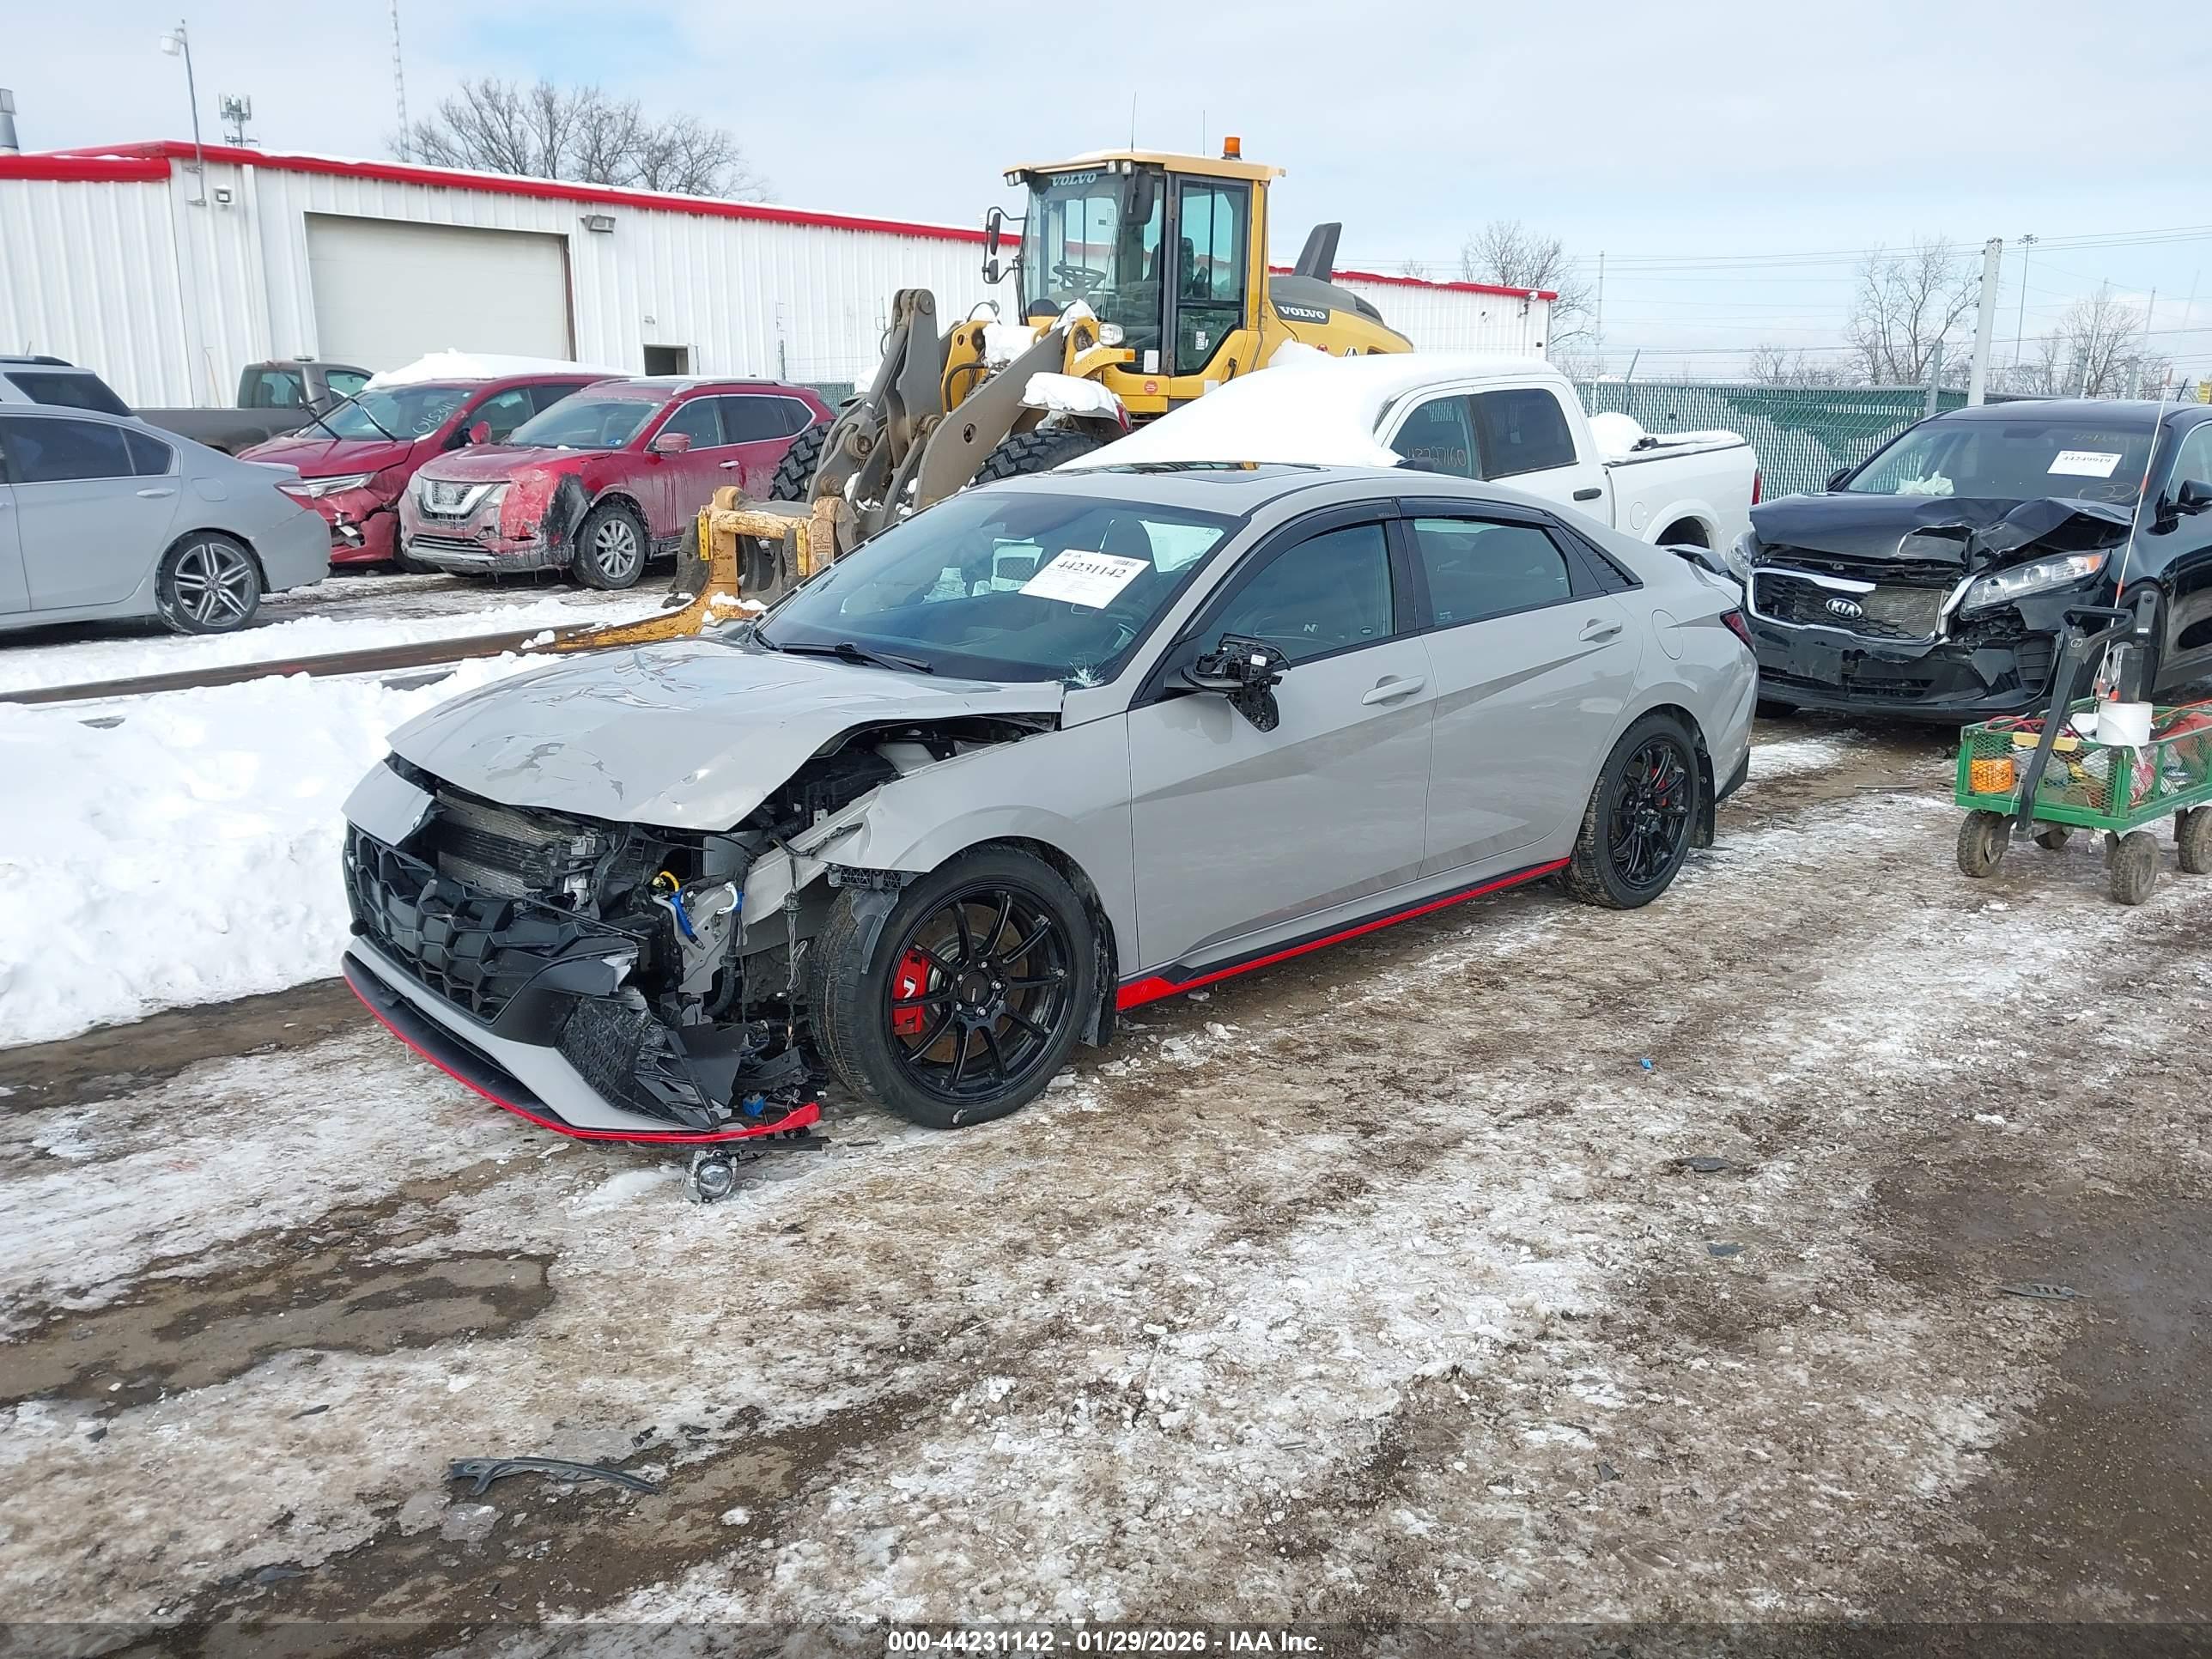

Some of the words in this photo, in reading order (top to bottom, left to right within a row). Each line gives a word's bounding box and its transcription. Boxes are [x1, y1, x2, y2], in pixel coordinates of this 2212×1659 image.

[1051, 173, 1097, 187] VOLVO
[1277, 305, 1326, 319] VOLVO
[1057, 560, 1127, 578] 44231142
[1831, 600, 1855, 617] KIA
